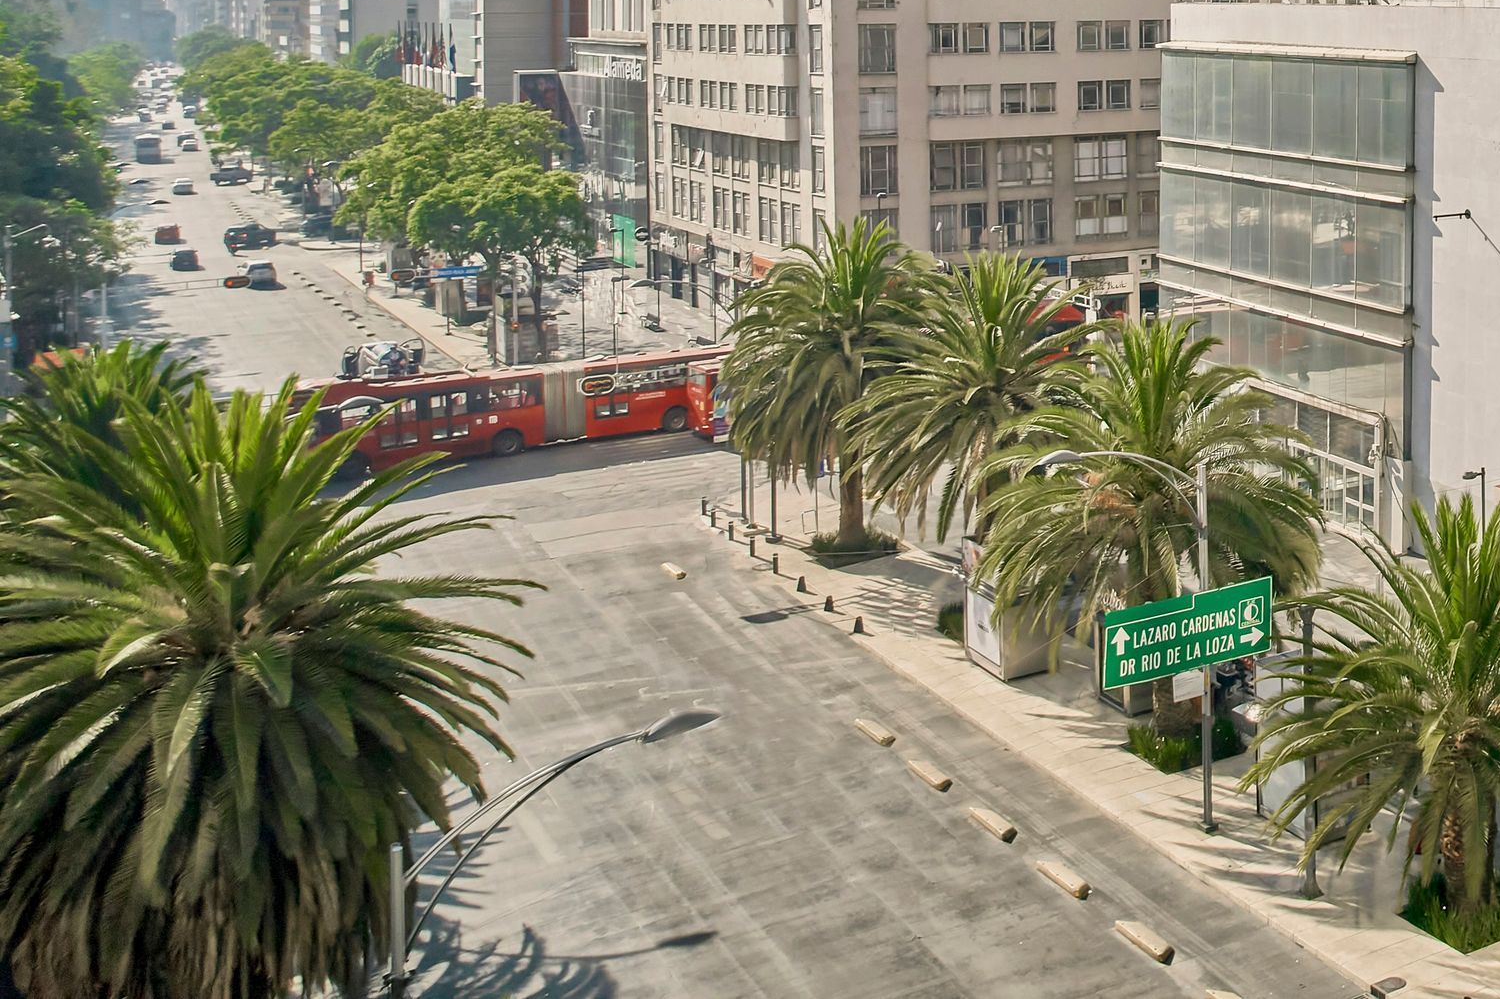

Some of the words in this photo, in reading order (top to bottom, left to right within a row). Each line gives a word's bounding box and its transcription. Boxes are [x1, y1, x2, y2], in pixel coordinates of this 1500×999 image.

[604, 54, 642, 80] Alameda
[1133, 622, 1176, 649] LAZARO
[1181, 608, 1236, 637] CARDENAS
[1119, 658, 1135, 677] DR
[1141, 651, 1161, 673] RIO
[1166, 646, 1181, 666] DE
[1186, 641, 1201, 661] LA
[1205, 633, 1235, 656] LOZA
